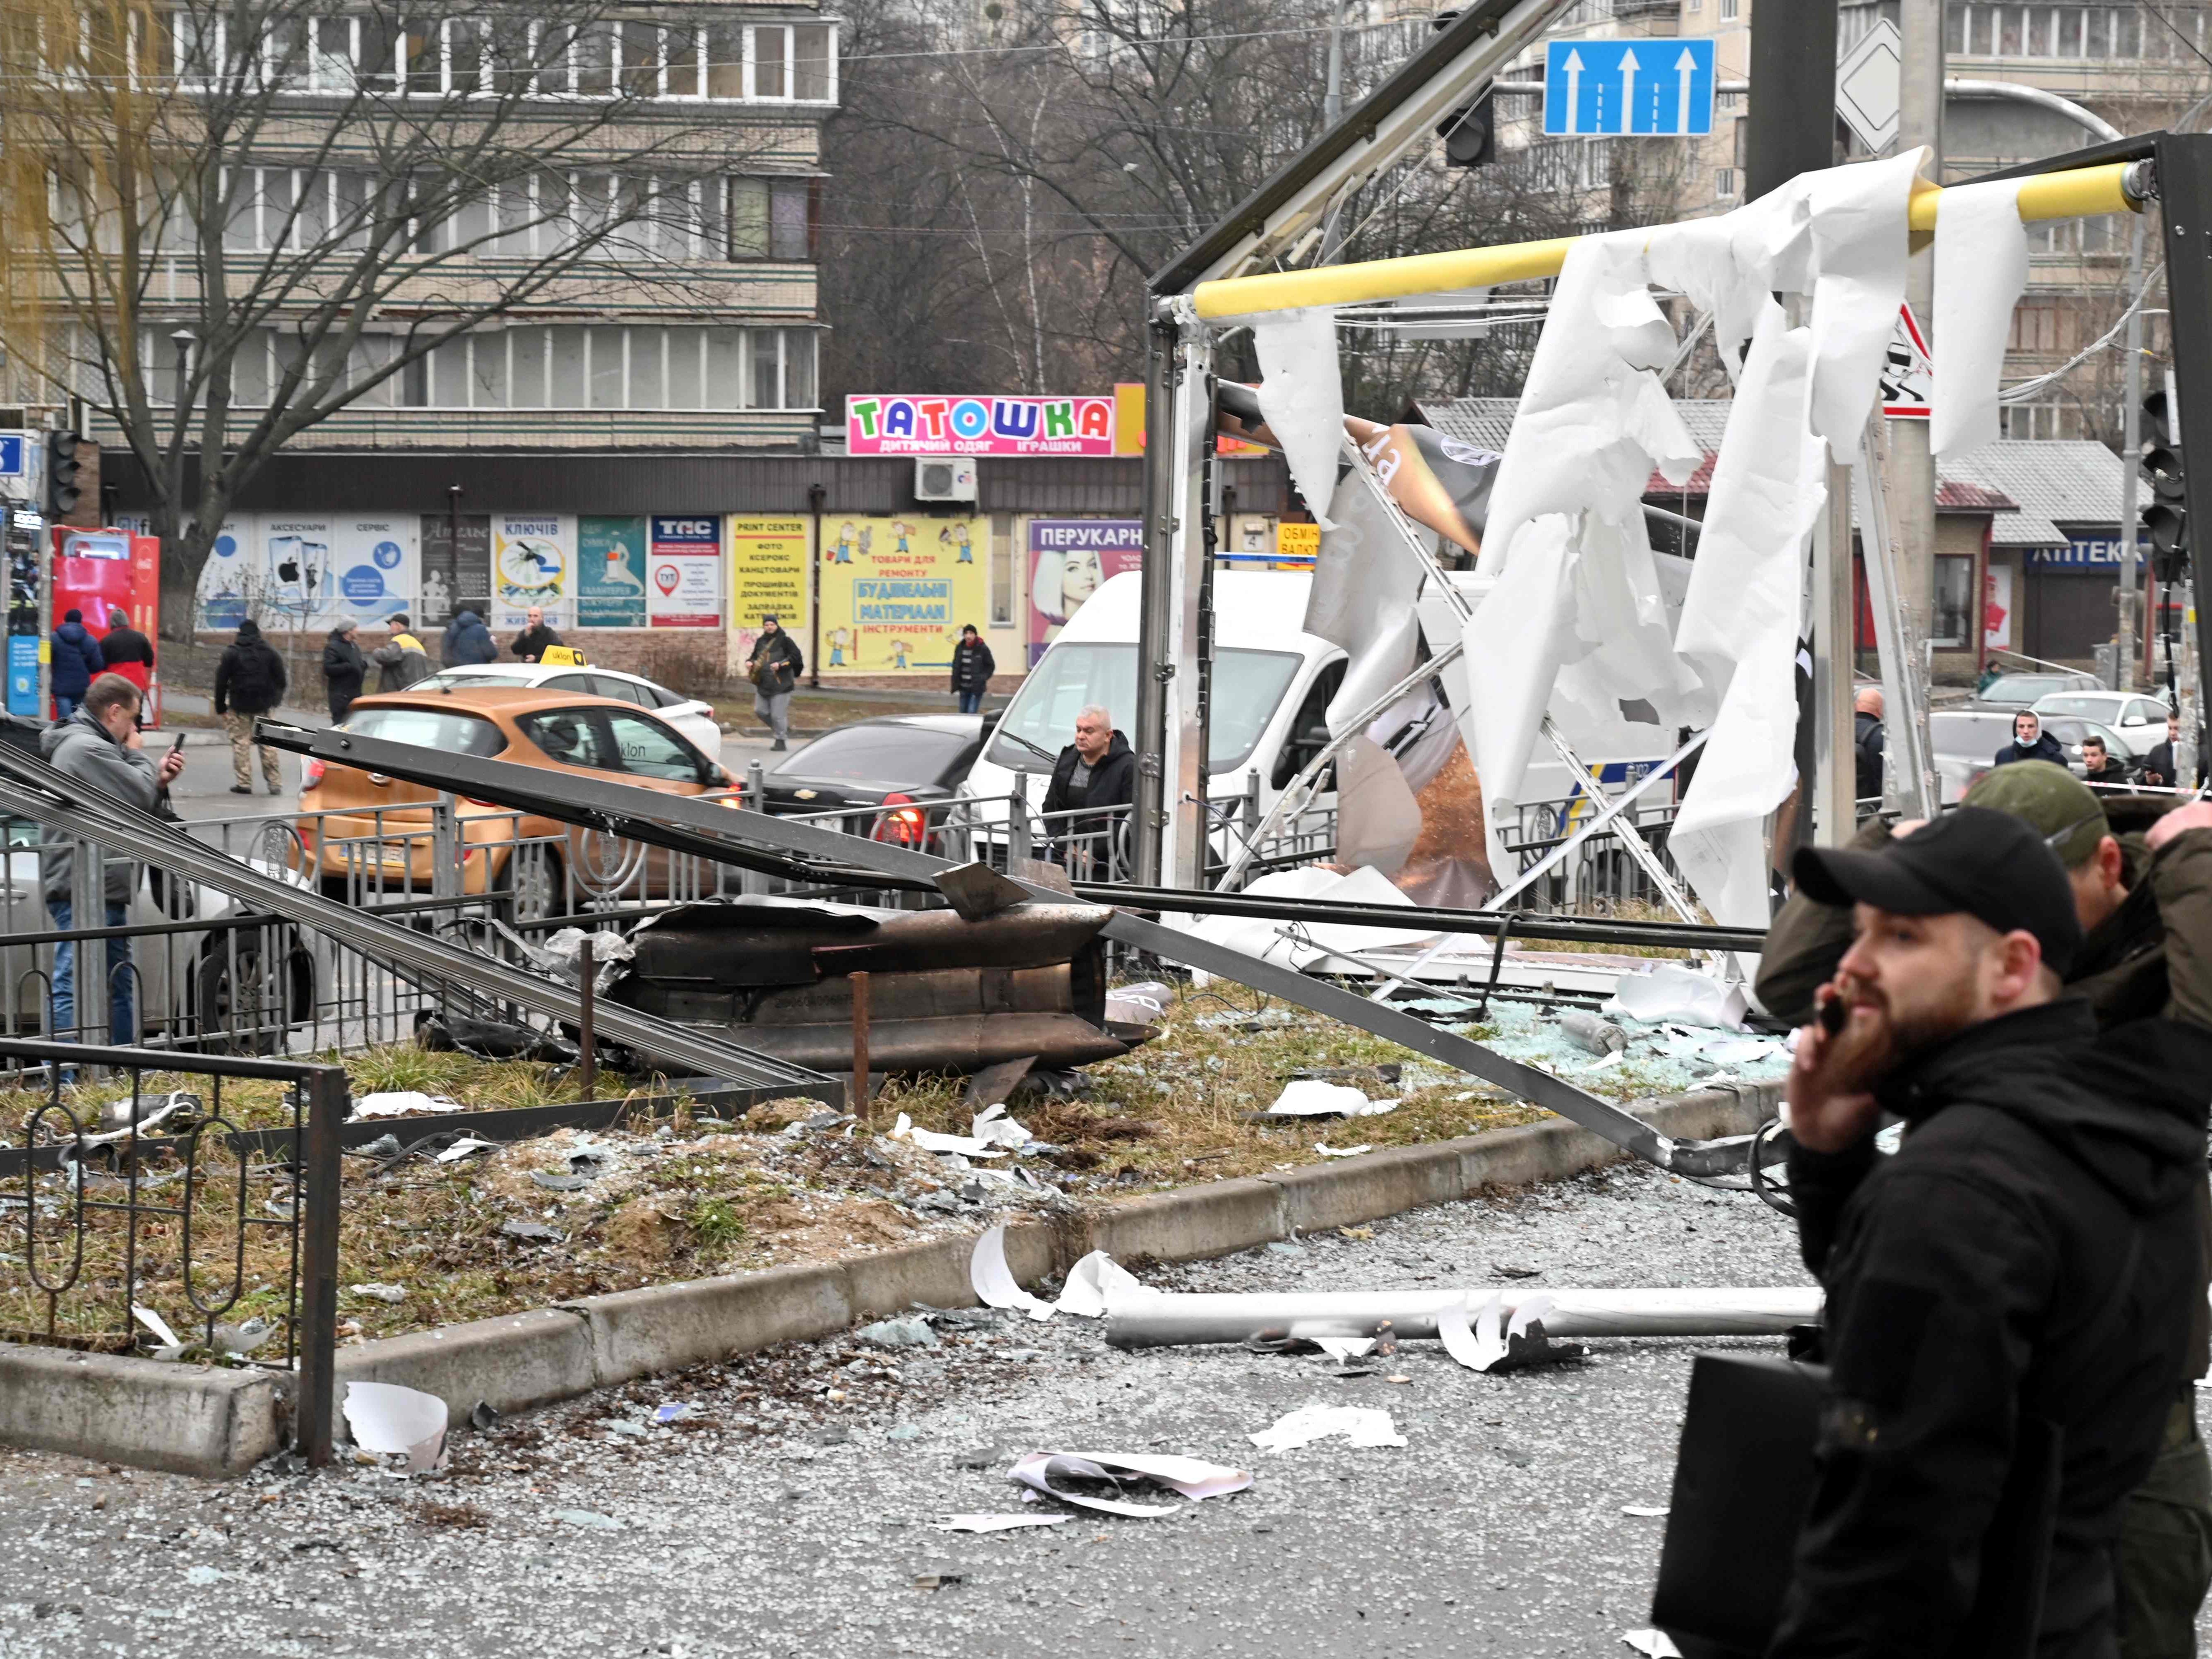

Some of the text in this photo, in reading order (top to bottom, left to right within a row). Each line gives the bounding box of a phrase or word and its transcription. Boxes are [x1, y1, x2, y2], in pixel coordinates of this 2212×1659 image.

[851, 398, 1112, 440] ТАТОШКА
[880, 439, 1082, 453] ДИТЯЧИЙ ОДЯГ ІГРАШКИ
[505, 523, 558, 535] КЛЮЧІВ
[659, 521, 711, 534] ТАС
[767, 523, 802, 531] CENTER
[1284, 527, 1319, 539] ОБМІН
[1040, 528, 1143, 545] ПЕРУКАРН
[914, 556, 935, 564] ДЛЯ
[863, 625, 943, 633] ІНСТРУМЕНТИ
